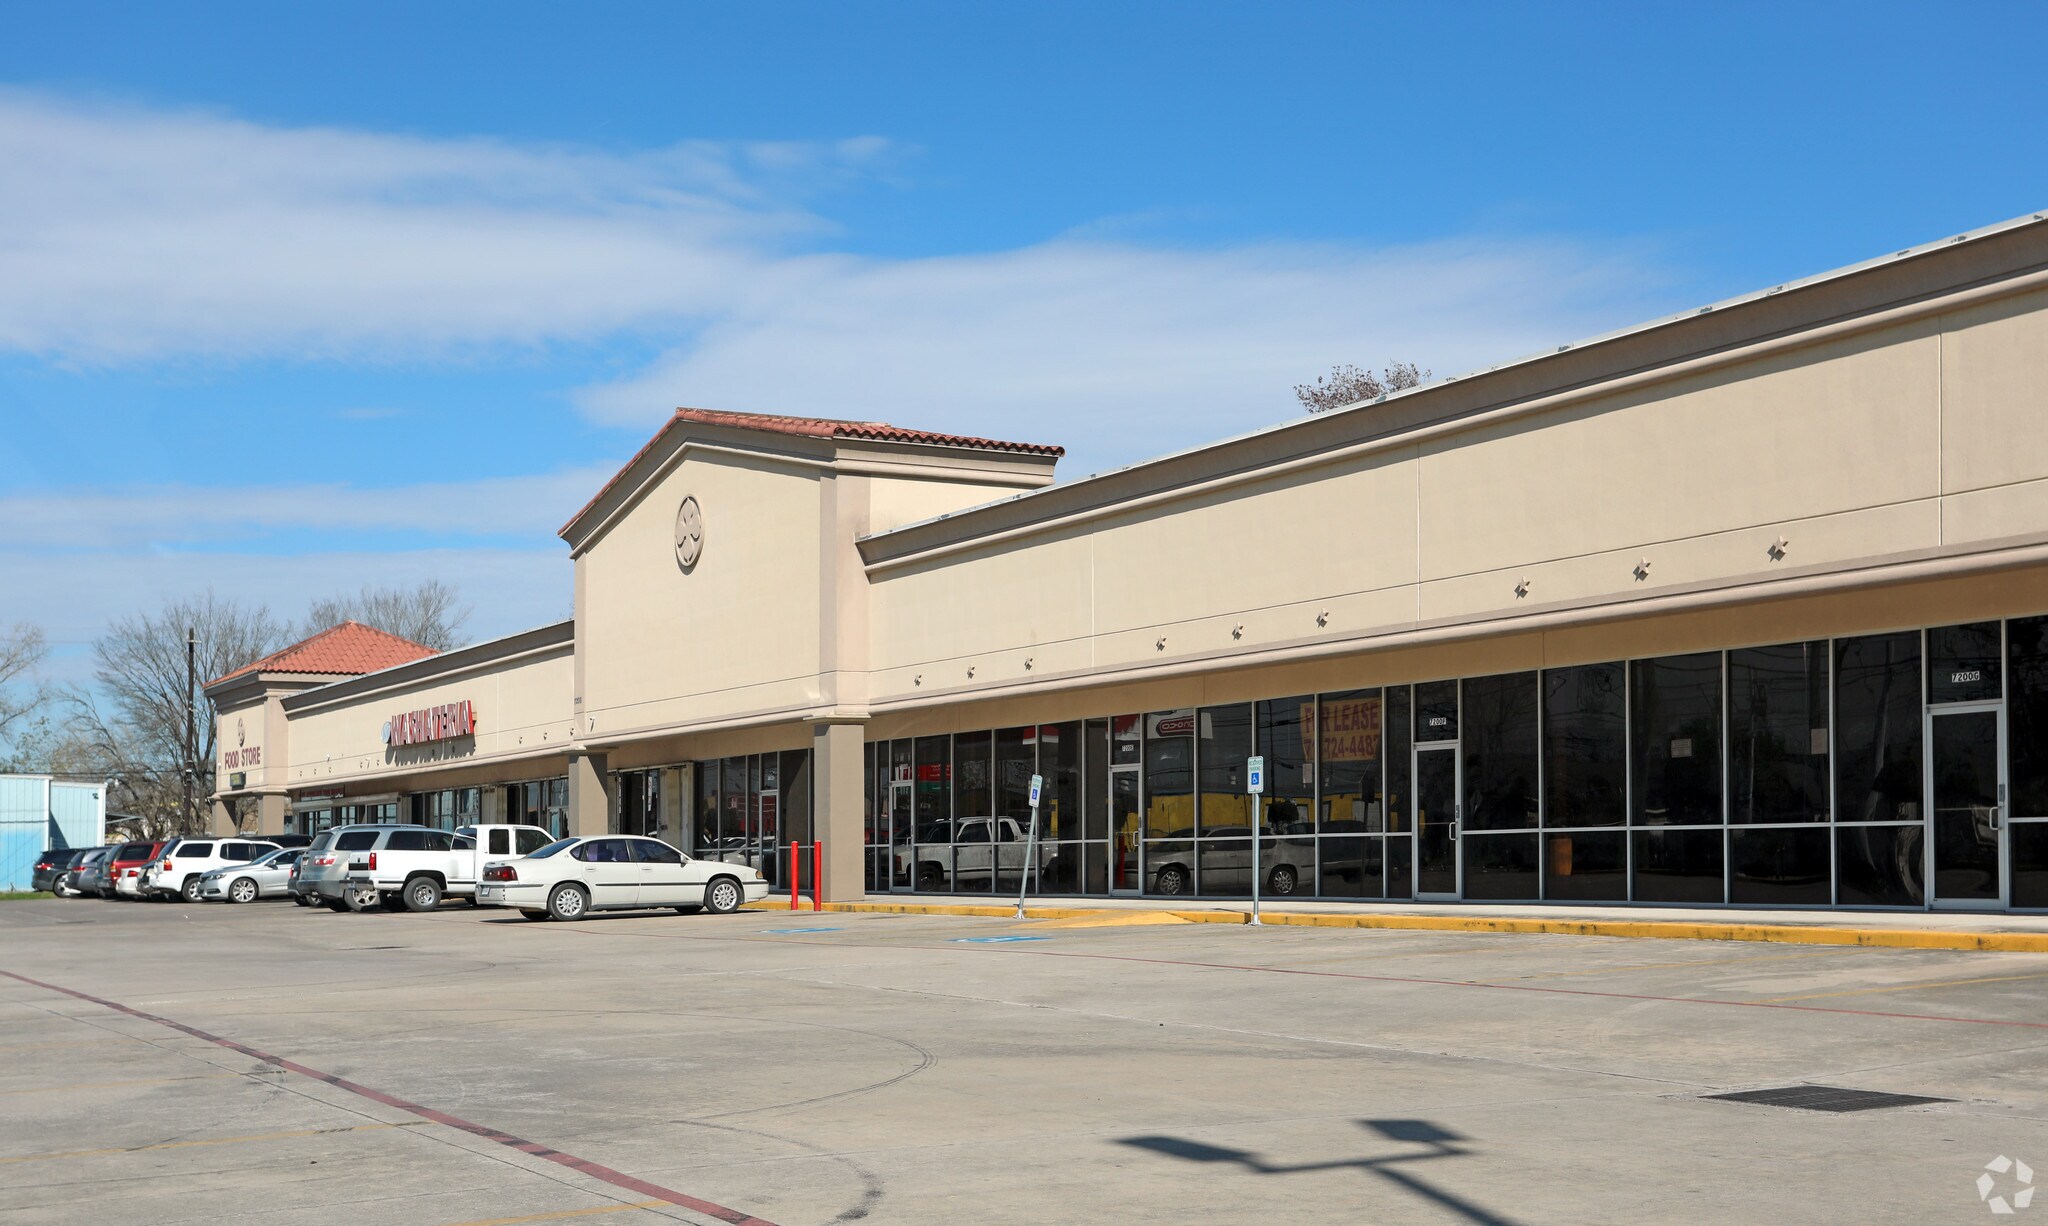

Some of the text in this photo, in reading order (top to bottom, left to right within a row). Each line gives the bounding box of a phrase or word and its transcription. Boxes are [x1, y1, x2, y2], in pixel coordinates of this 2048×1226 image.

[1952, 671, 1979, 682] 7200G
[391, 700, 474, 747] WASHATERIA
[1304, 701, 1379, 733] FR LEASE
[225, 746, 261, 770] FOOD STORE
